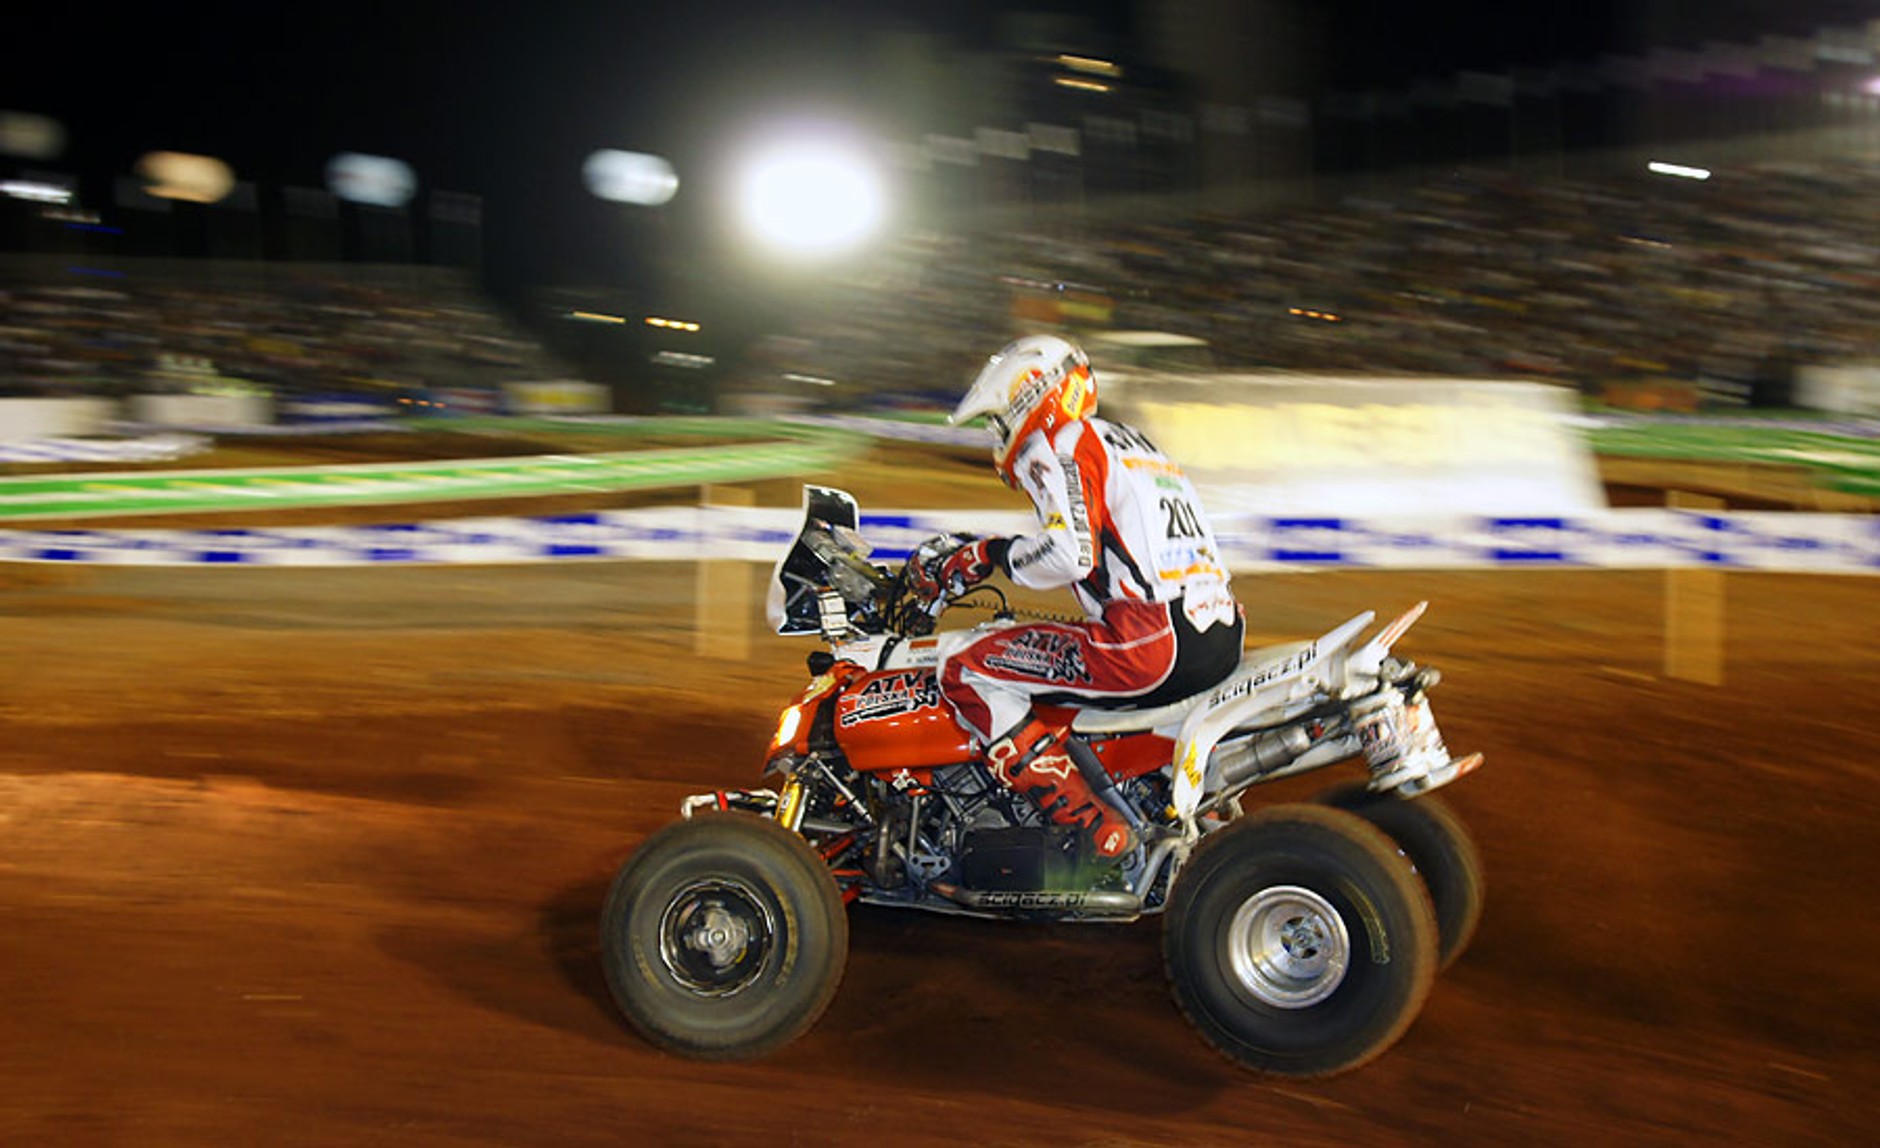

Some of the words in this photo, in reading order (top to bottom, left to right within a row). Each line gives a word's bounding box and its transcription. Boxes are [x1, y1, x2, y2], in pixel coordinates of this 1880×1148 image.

[1159, 496, 1205, 539] 201
[1011, 629, 1071, 653] ATV
[860, 669, 923, 696] ATV
